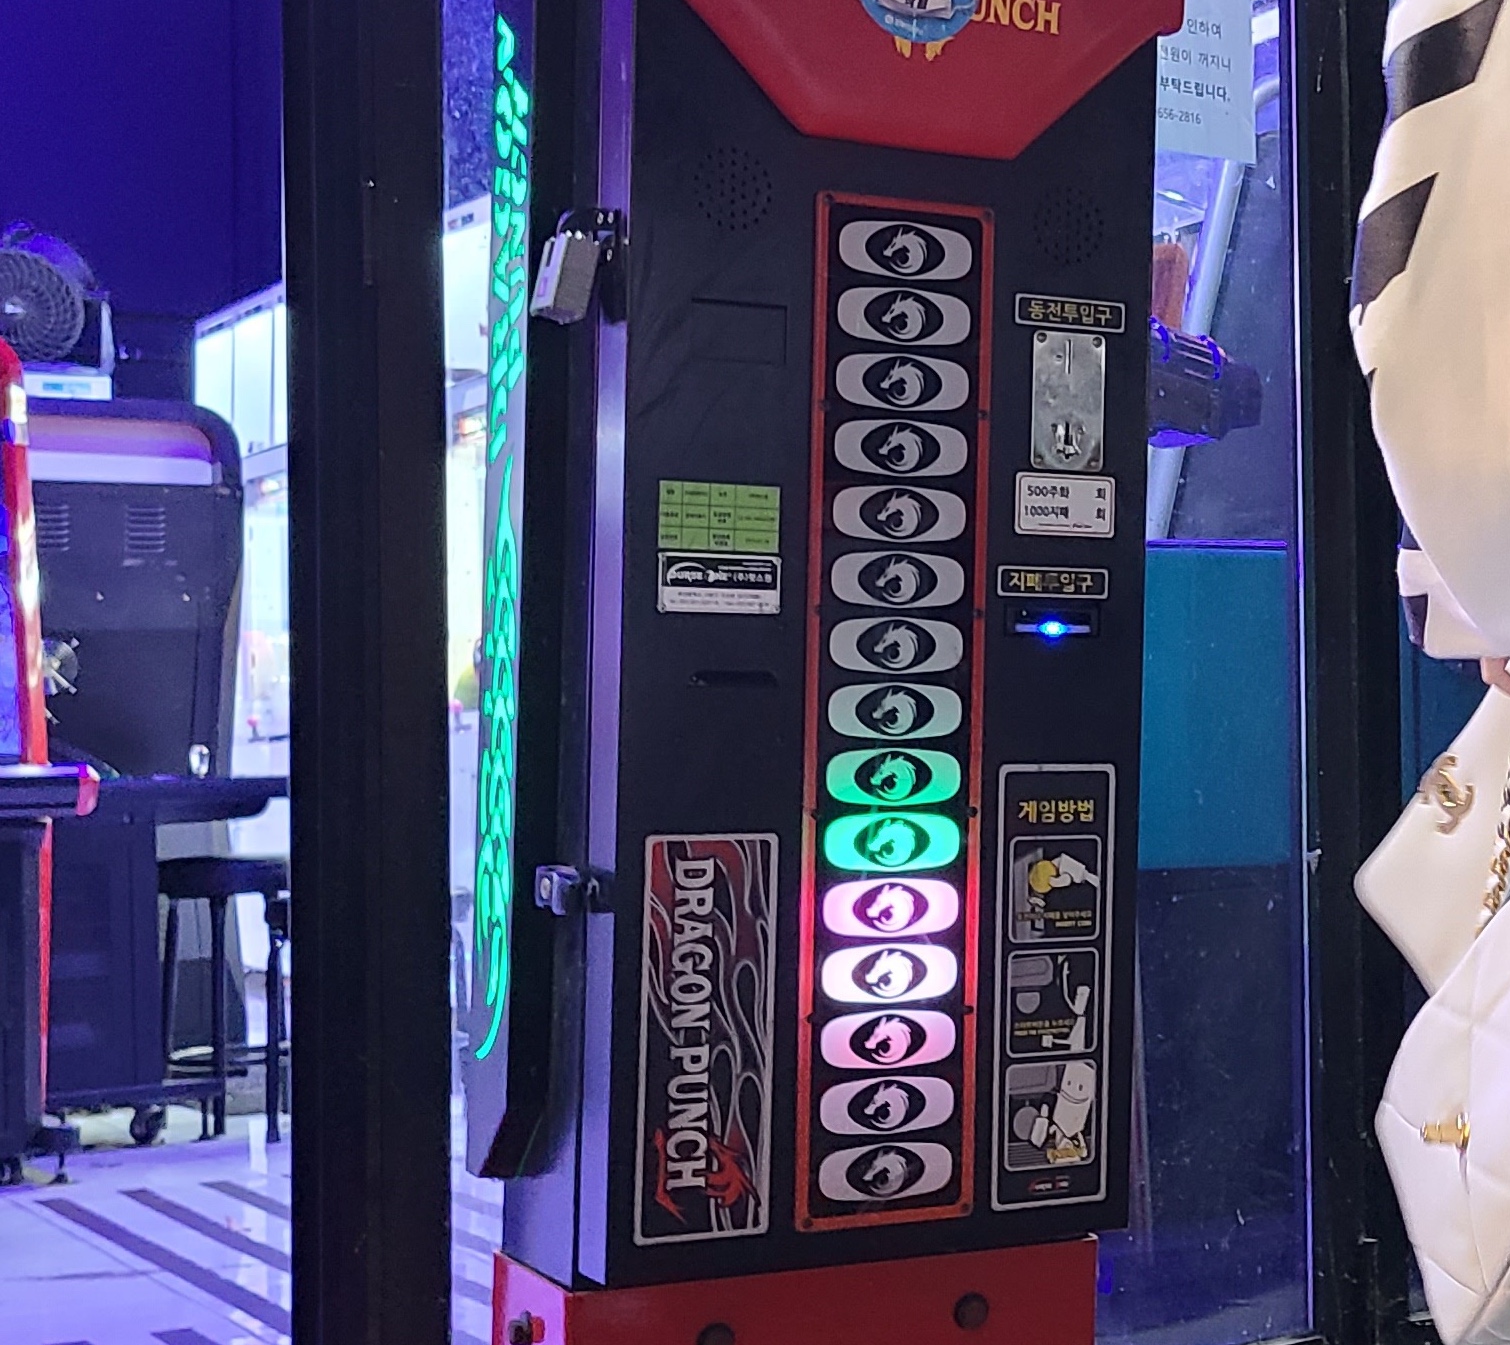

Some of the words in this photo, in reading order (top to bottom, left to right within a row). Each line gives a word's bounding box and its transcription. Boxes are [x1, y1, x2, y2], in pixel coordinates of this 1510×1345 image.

[1187, 18, 1222, 39] 인하여
[1198, 52, 1232, 72] 꺼지니
[1028, 299, 1112, 326] 동전투입구
[1018, 799, 1095, 824] 게임방법
[671, 858, 715, 1030] DRAGON
[666, 1044, 710, 1191] PUNCH
